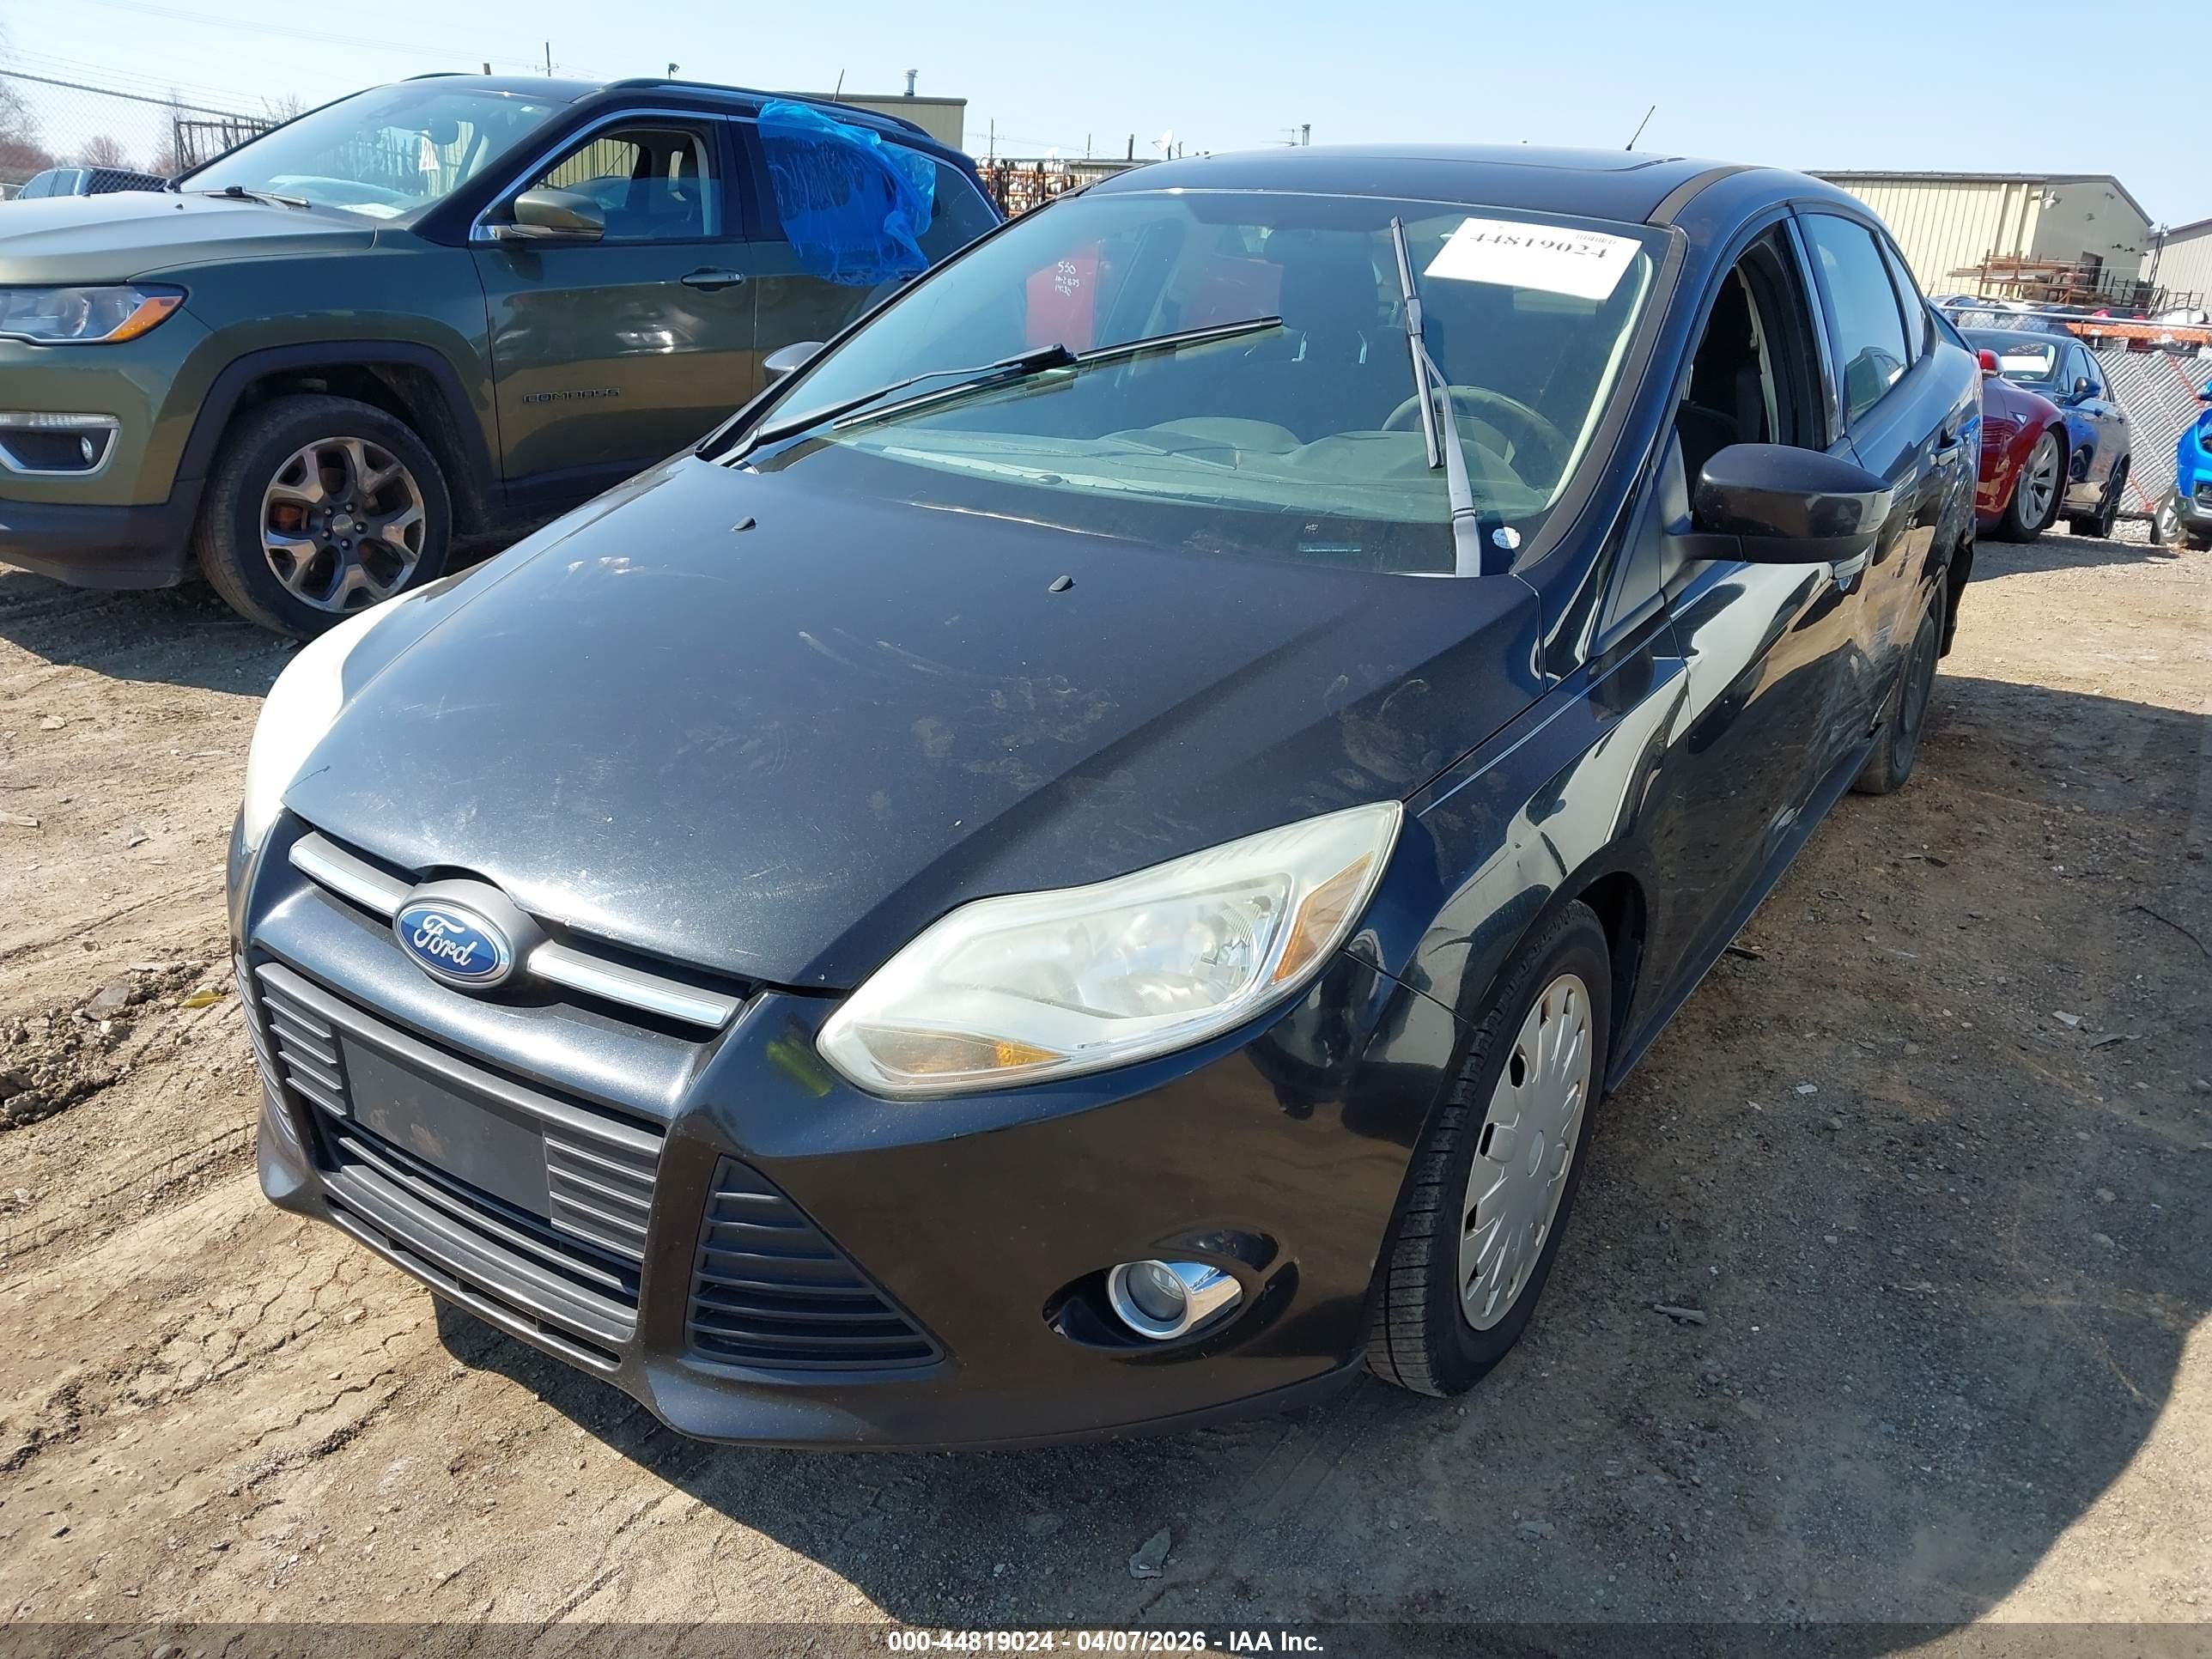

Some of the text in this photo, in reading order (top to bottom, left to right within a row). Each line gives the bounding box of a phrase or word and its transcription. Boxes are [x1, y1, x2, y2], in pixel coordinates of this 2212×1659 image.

[1469, 232, 1608, 258] 44819024
[522, 387, 620, 404] COMPASS
[413, 915, 477, 966] Ford
